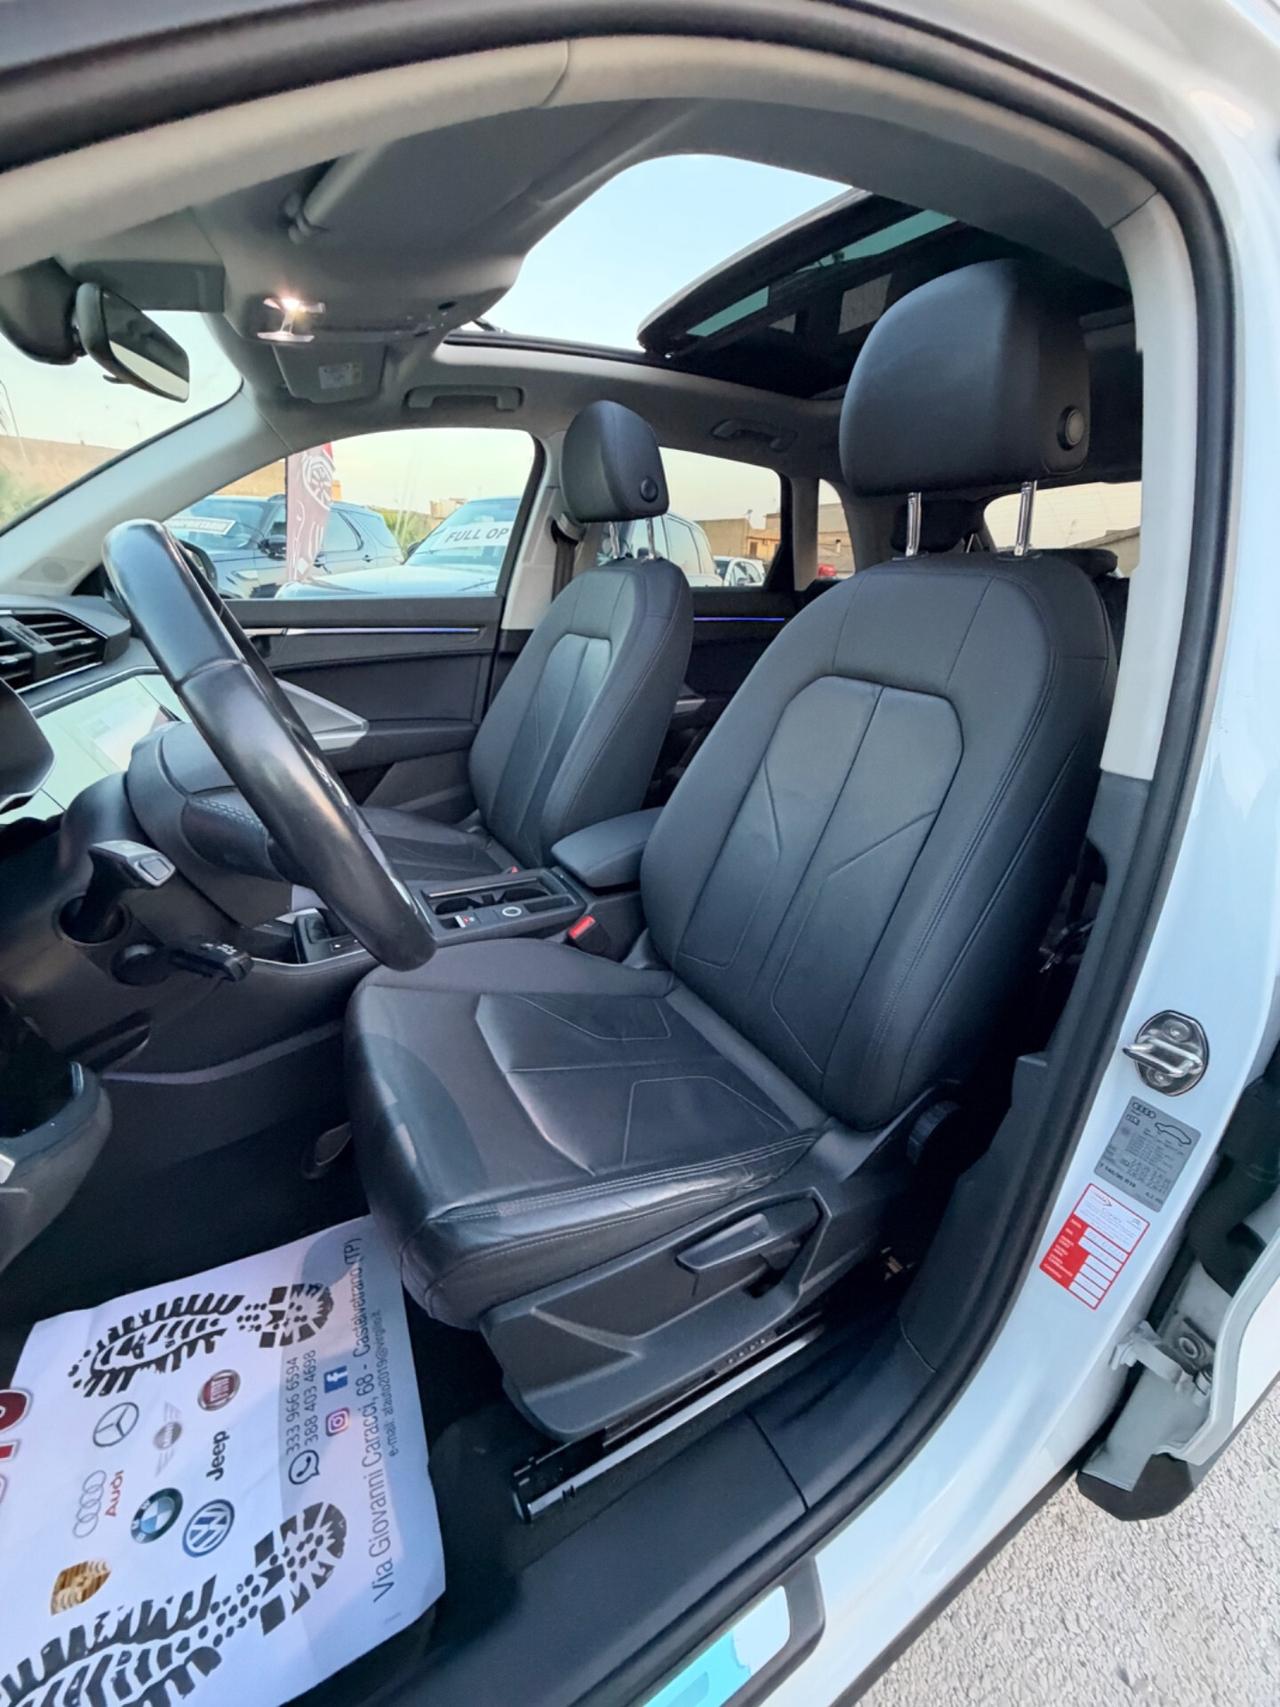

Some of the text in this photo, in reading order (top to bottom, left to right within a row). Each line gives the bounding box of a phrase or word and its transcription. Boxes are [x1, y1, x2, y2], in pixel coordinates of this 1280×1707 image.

[444, 528, 510, 543] FULL OP
[343, 1238, 364, 1265] (TP)
[350, 1267, 371, 1358] Castelvetrano
[286, 1357, 300, 1456] 333 966 6594
[303, 1350, 319, 1446] 388 403 4698
[355, 1373, 375, 1397] 68
[206, 1430, 230, 1481] Jeep
[358, 1396, 383, 1468] Caracci,
[105, 1470, 125, 1517] Audi
[363, 1469, 392, 1558] Giovanni
[371, 1557, 396, 1603] Via
